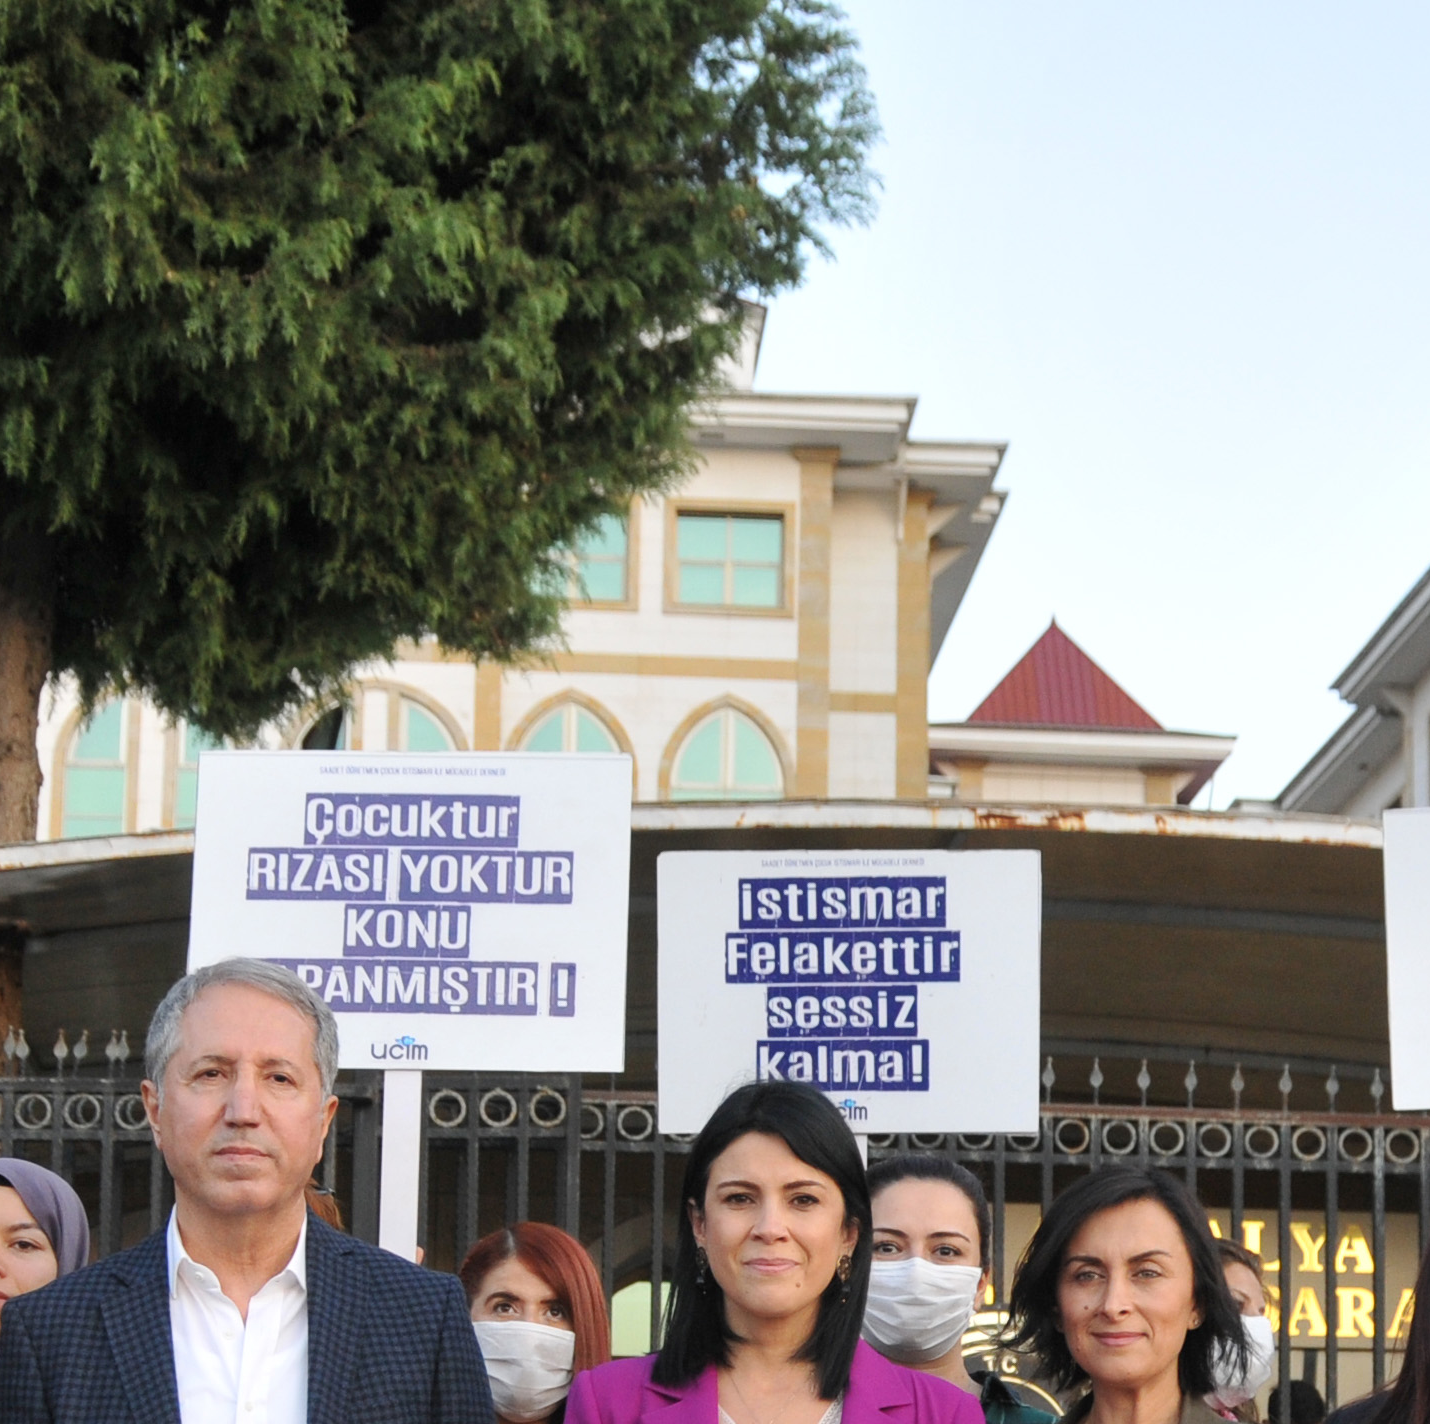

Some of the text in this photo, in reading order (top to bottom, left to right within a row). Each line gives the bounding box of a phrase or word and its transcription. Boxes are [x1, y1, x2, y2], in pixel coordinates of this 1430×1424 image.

[306, 797, 518, 845] Çocuktur
[249, 852, 572, 895] RIZASI YOKTUR
[741, 882, 945, 922] istismar
[345, 908, 468, 949] KONU
[727, 935, 959, 976] Felakettir
[281, 964, 536, 1012] PANMIŞTIR
[768, 990, 916, 1029] sessiz
[759, 1044, 923, 1083] kalma!
[837, 1104, 868, 1121] cim
